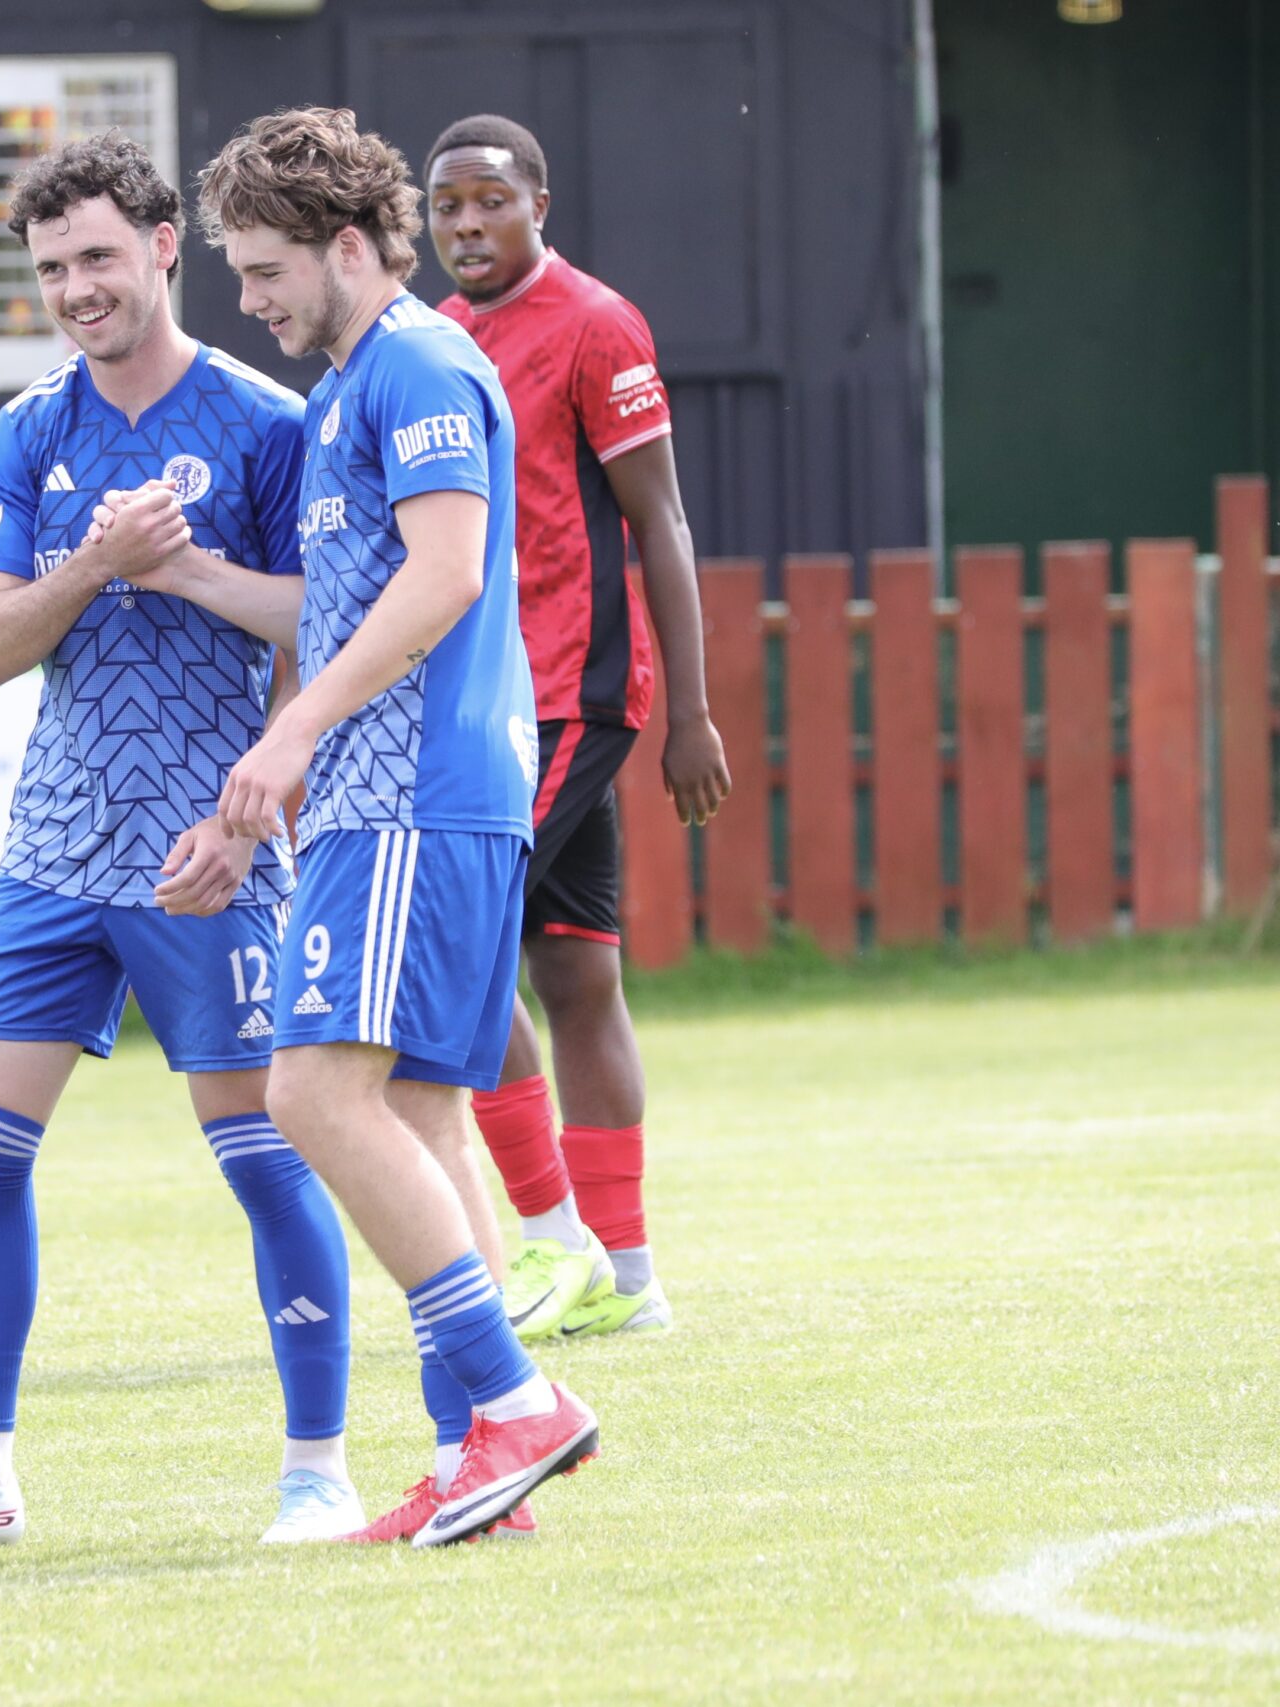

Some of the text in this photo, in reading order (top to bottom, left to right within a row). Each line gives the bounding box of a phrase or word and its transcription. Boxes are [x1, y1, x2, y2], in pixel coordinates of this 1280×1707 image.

[393, 413, 473, 464] DUFFER
[229, 945, 272, 1004] 12
[304, 924, 331, 980] 9
[237, 1025, 275, 1039] adidas
[293, 1003, 333, 1015] adidas
